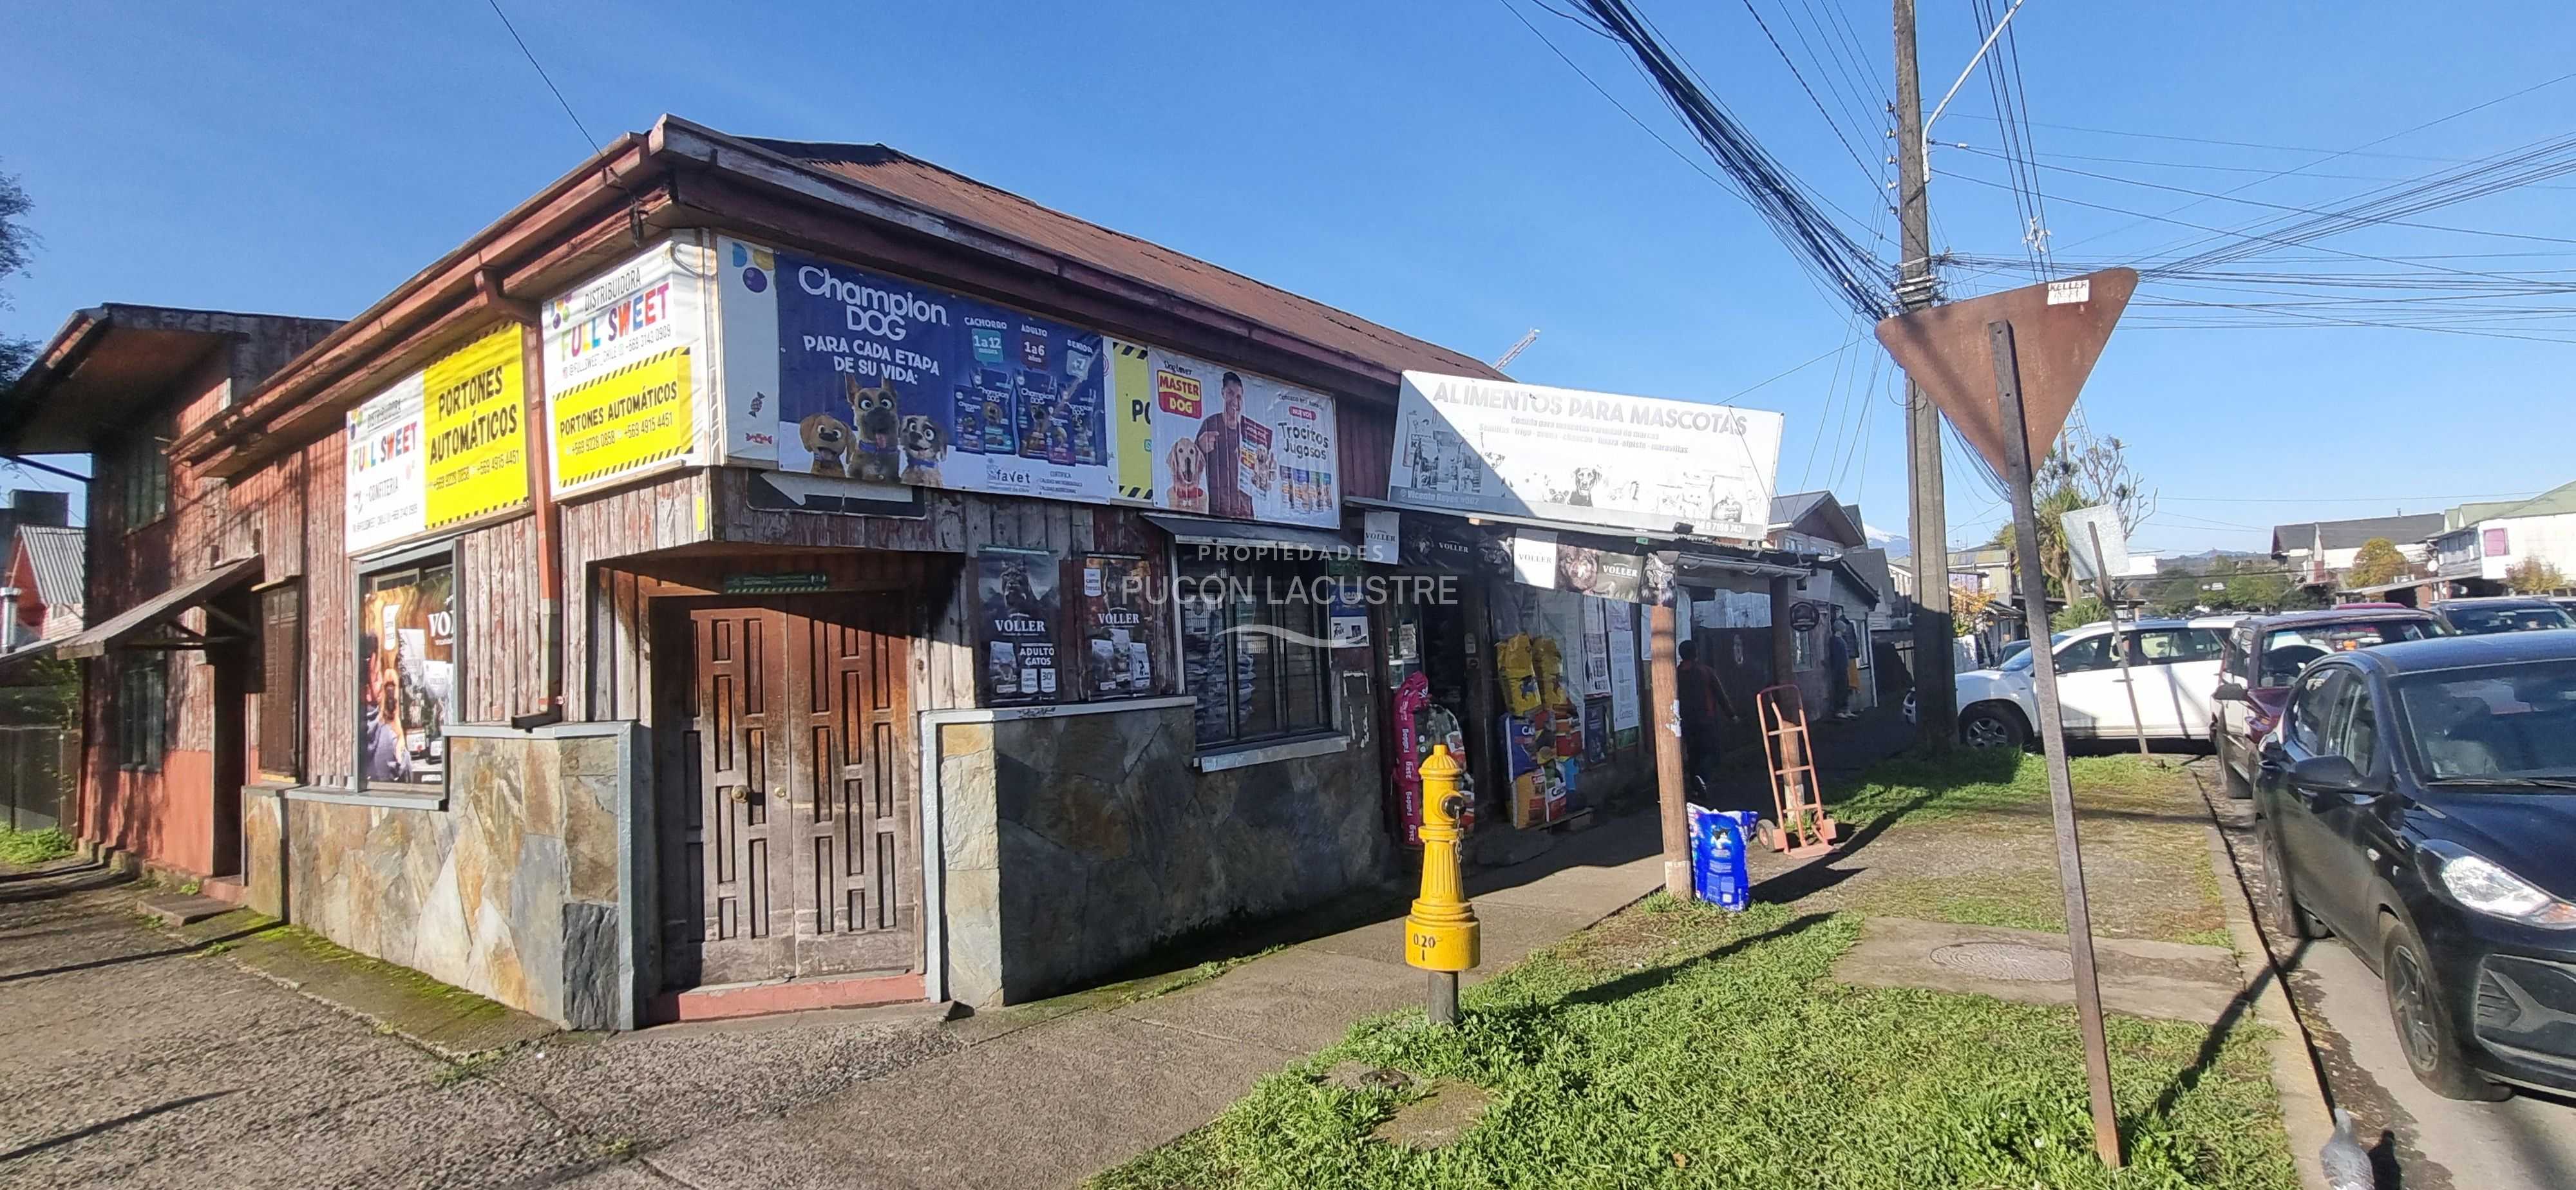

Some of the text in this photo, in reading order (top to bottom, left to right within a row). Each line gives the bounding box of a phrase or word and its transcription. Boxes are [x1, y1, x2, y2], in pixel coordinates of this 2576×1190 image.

[585, 267, 641, 312] DISTRIBUIDORA
[798, 264, 947, 326] Champion
[2050, 281, 2087, 292] KELLER
[561, 282, 670, 362] FULL SWEET
[846, 304, 907, 341] DOG
[802, 334, 940, 377] PARA CADA ETAPA
[833, 355, 855, 374] DE
[857, 359, 878, 378] SU
[438, 364, 503, 421] PORTONES
[1159, 375, 1199, 396] MASTER
[560, 381, 677, 439] PORTONES AUTOMÁTICOS
[1169, 397, 1193, 413] DOG
[1433, 381, 1748, 435] ALIMENTOS PARA MASCOTAS
[429, 403, 518, 465] AUTOMÁTICOS
[1277, 421, 1329, 449] Trocitos
[352, 420, 418, 477] FULL SWEET
[1283, 440, 1327, 460] Jugosos
[1365, 532, 1396, 543] VOLLER
[1438, 542, 1469, 554] VOLLER
[1519, 552, 1553, 565] VOLLER
[1602, 564, 1639, 579] VOLLER
[994, 618, 1046, 634] VOLLER
[1097, 612, 1141, 625] VOLLER
[1019, 646, 1056, 657] ADULTO
[1025, 657, 1052, 666] GATOS
[1413, 933, 1436, 949] 0.20
